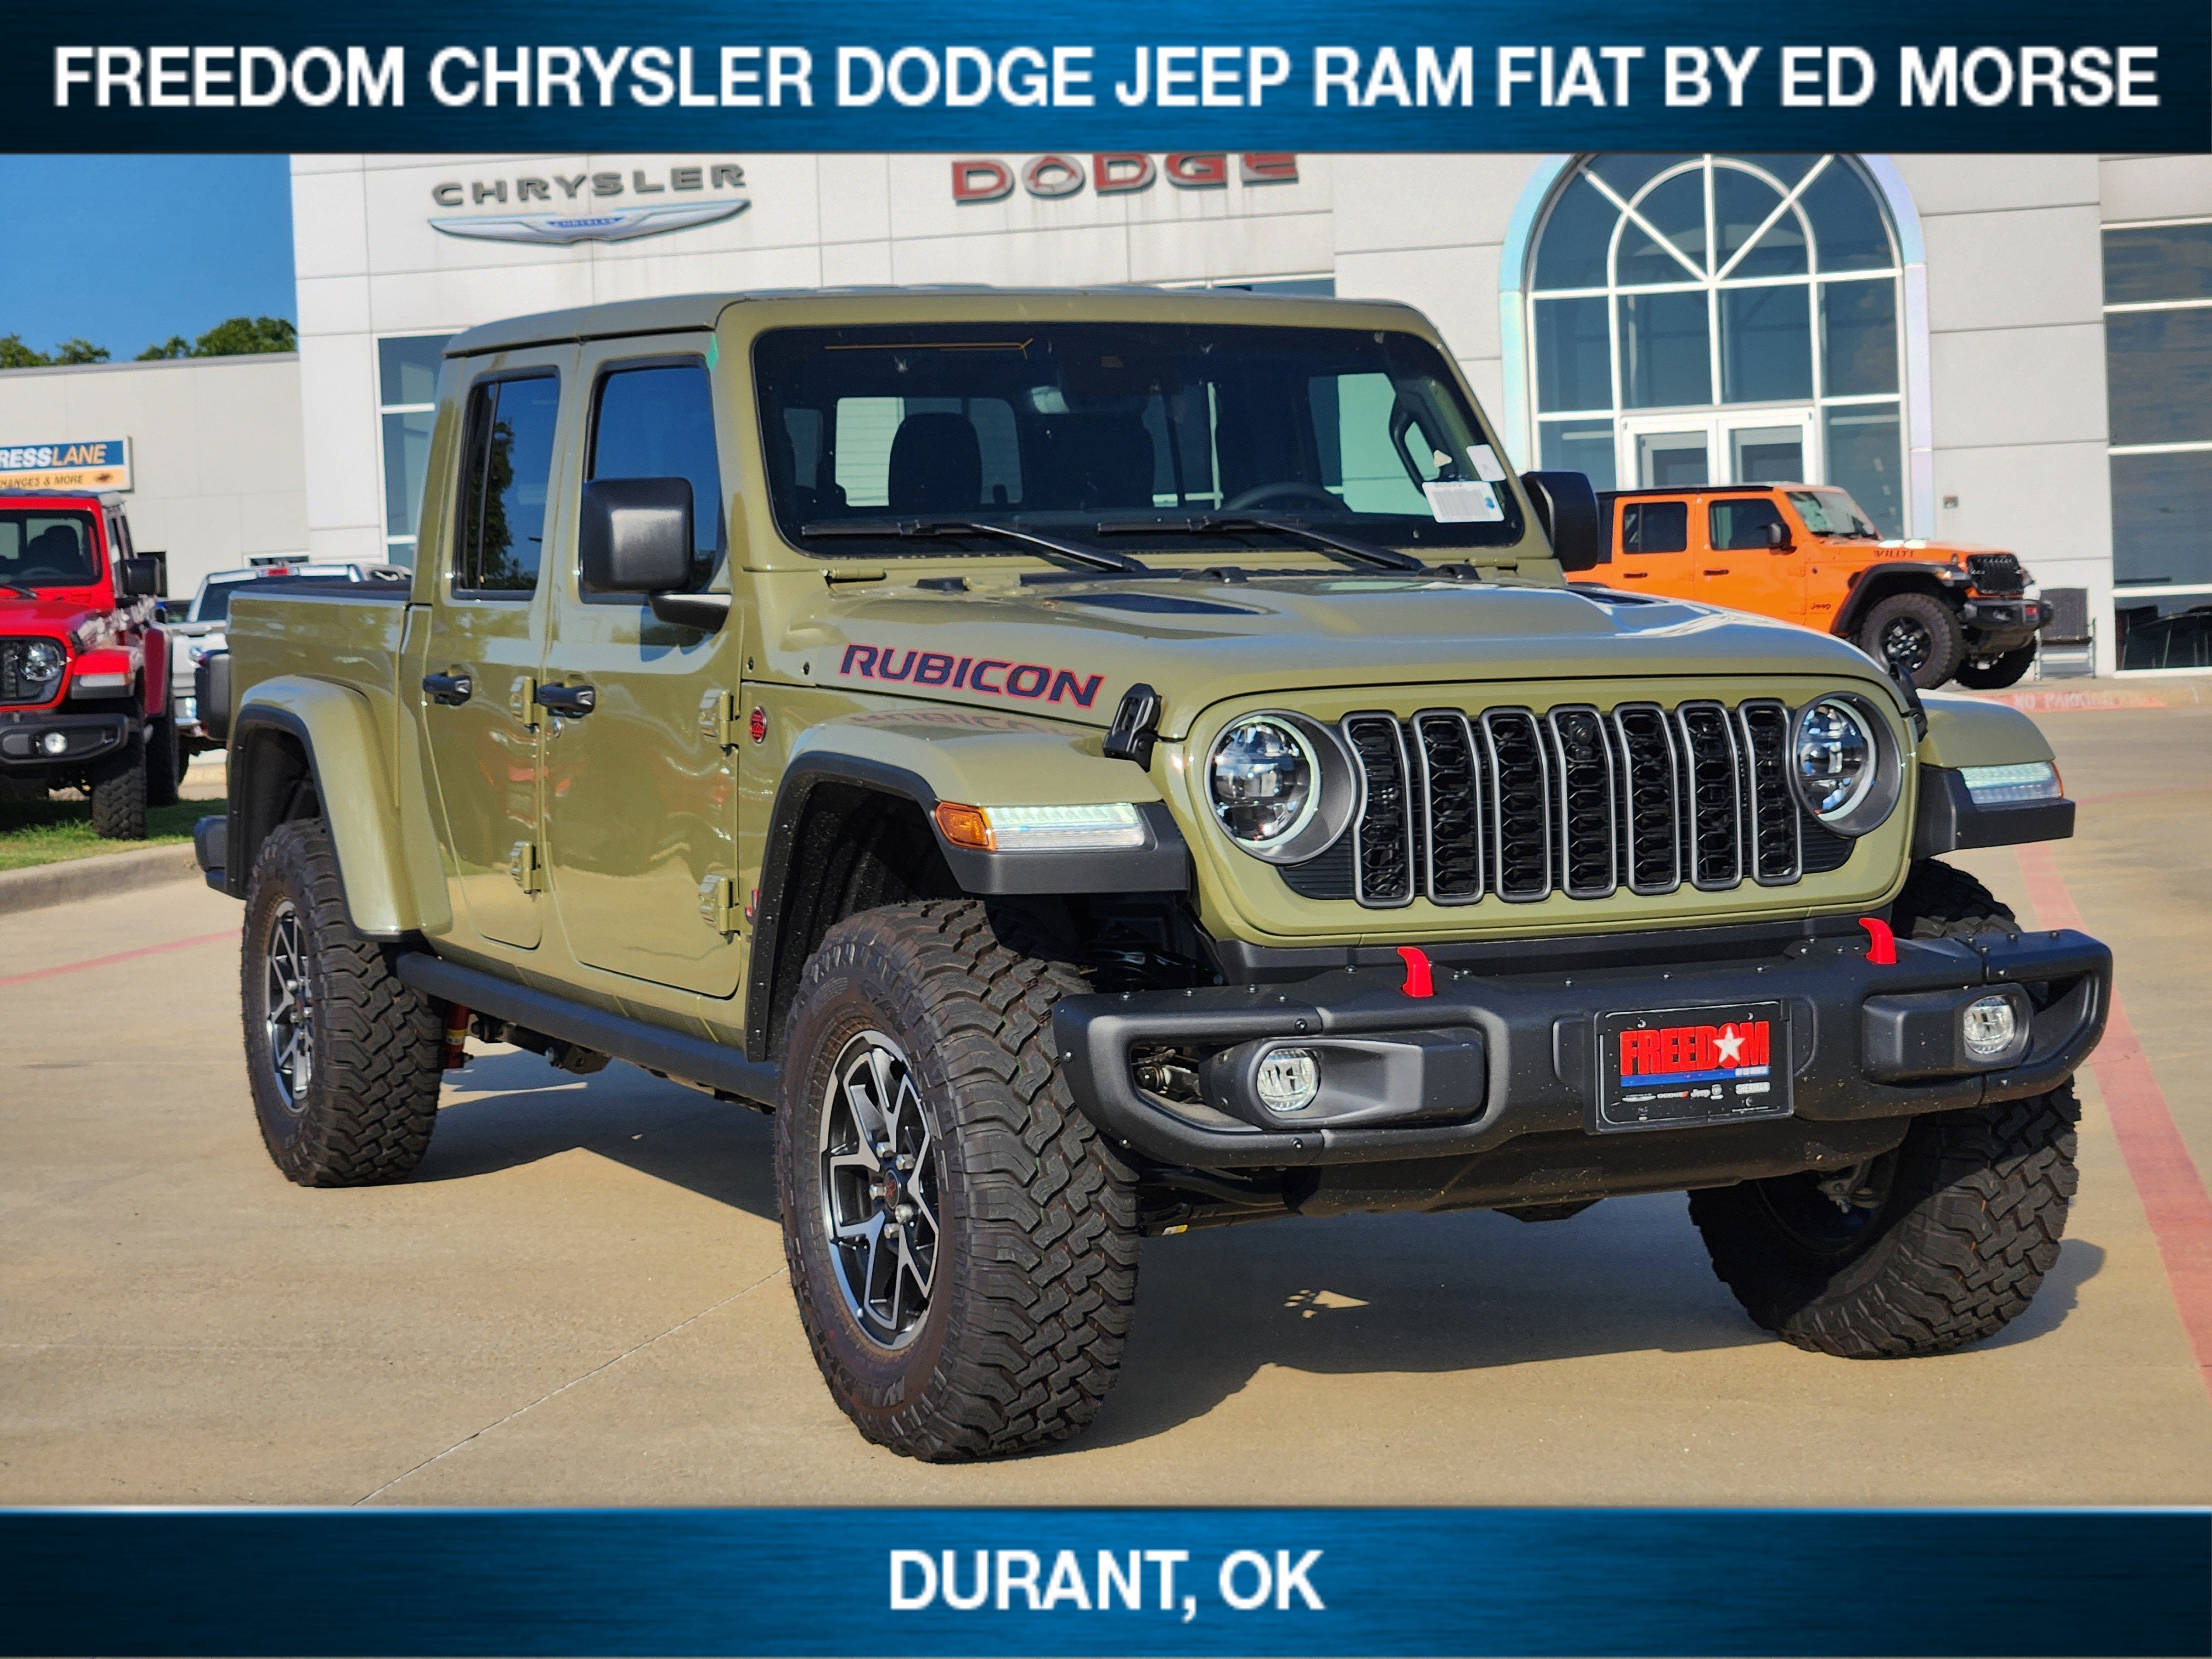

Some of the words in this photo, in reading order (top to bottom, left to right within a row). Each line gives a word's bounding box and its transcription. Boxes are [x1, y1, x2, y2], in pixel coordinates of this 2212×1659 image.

[432, 164, 748, 206] CHRYSLER
[952, 154, 1299, 205] DODGE
[44, 476, 50, 486] &
[55, 474, 84, 485] MORE
[839, 644, 1105, 709] RUBICON
[2013, 693, 2036, 711] NO
[1620, 1021, 1770, 1076] FREEDOM
[1735, 1082, 1771, 1095] SHERMAN
